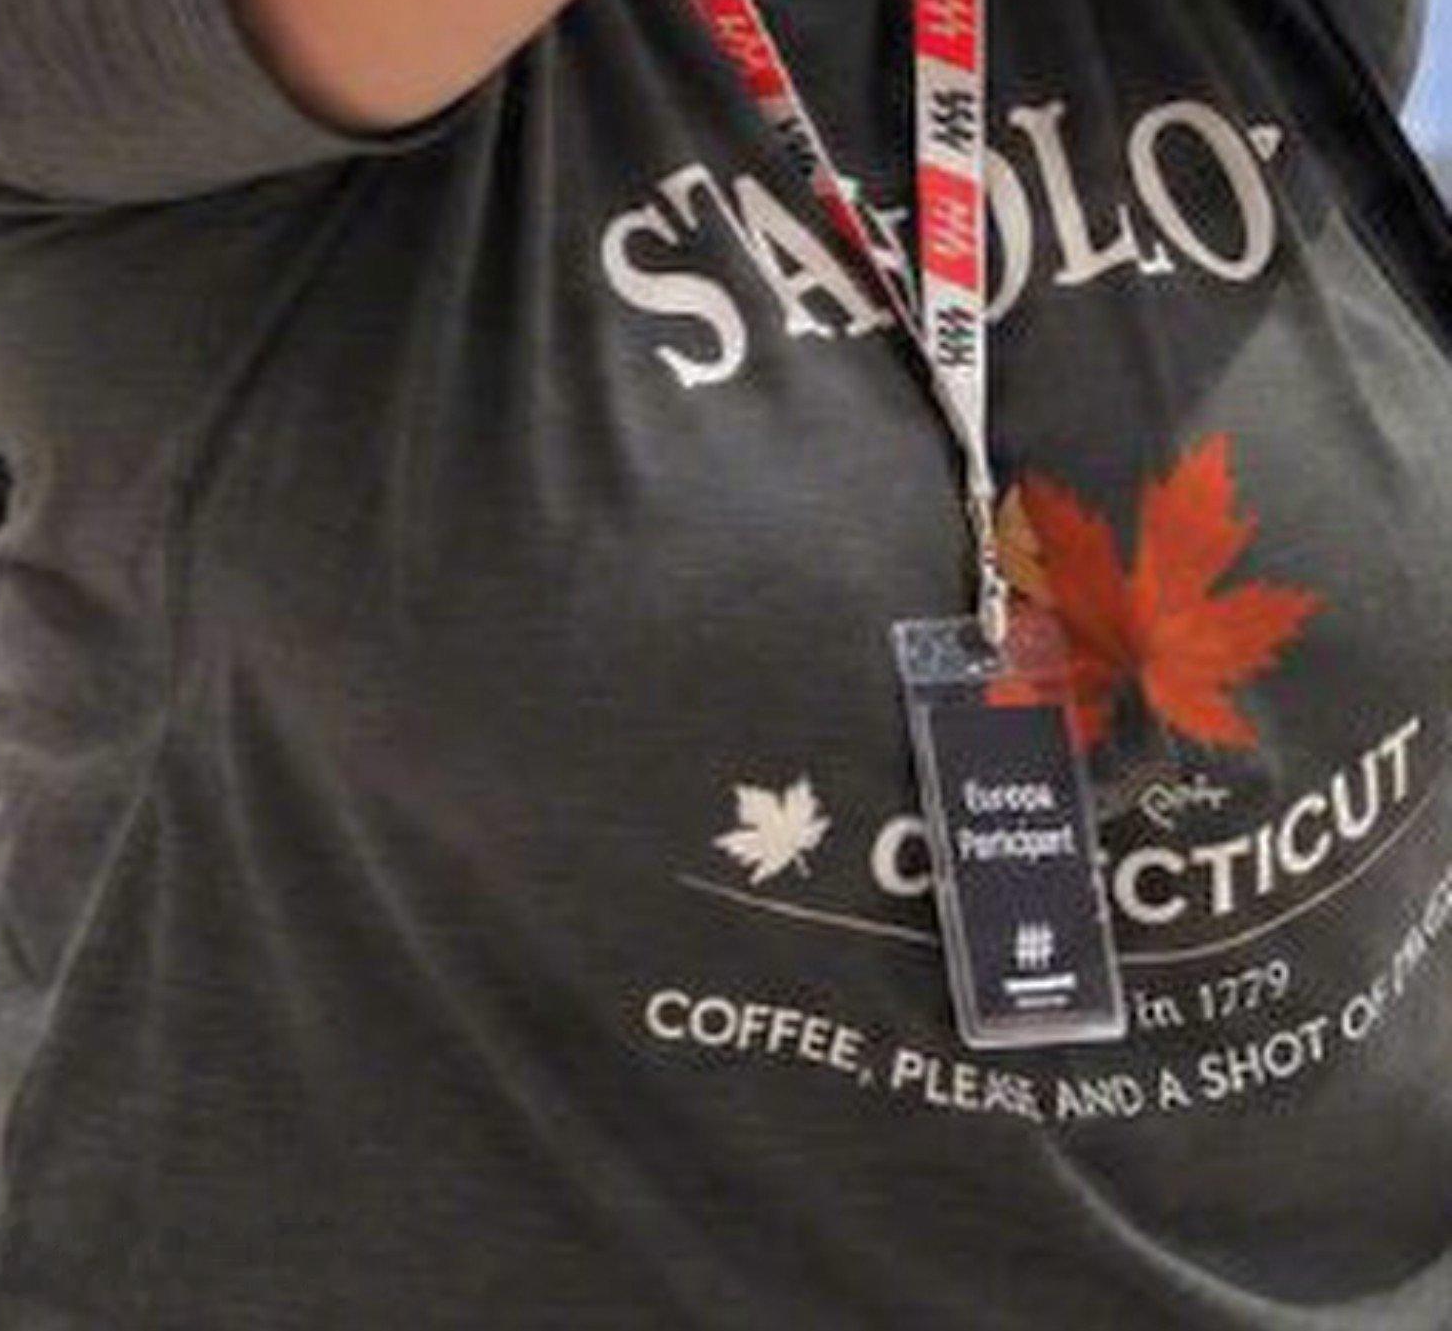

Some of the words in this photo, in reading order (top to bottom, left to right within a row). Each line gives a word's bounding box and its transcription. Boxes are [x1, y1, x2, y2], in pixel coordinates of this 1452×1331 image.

[1055, 1073, 1145, 1122] AND
[1158, 1065, 1193, 1111] A
[1198, 1014, 1329, 1100] SHOT
